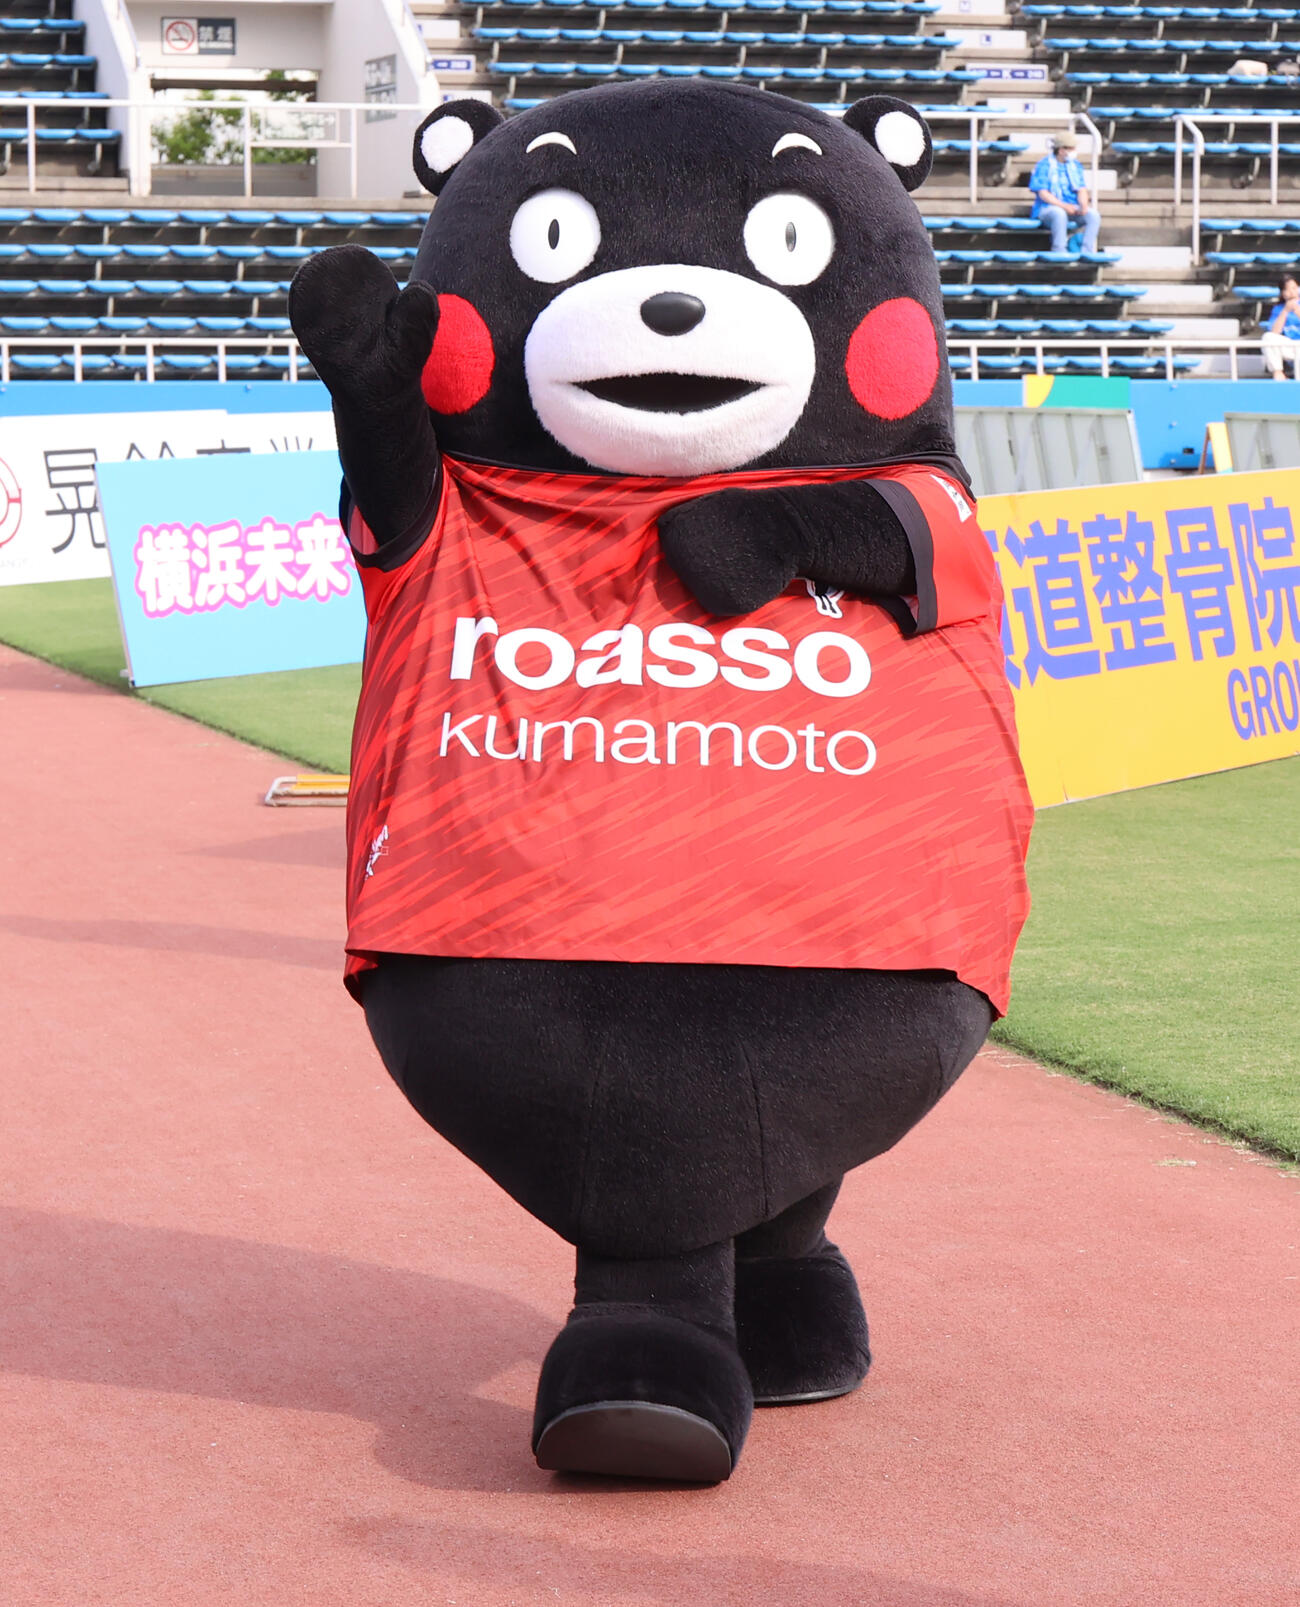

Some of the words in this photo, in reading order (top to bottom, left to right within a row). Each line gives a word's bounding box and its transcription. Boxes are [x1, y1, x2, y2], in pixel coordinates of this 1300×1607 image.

[134, 514, 352, 616] 横浜未来
[984, 497, 1300, 690] 道整骨院
[450, 616, 872, 697] roasso
[439, 712, 877, 776] kumamoto
